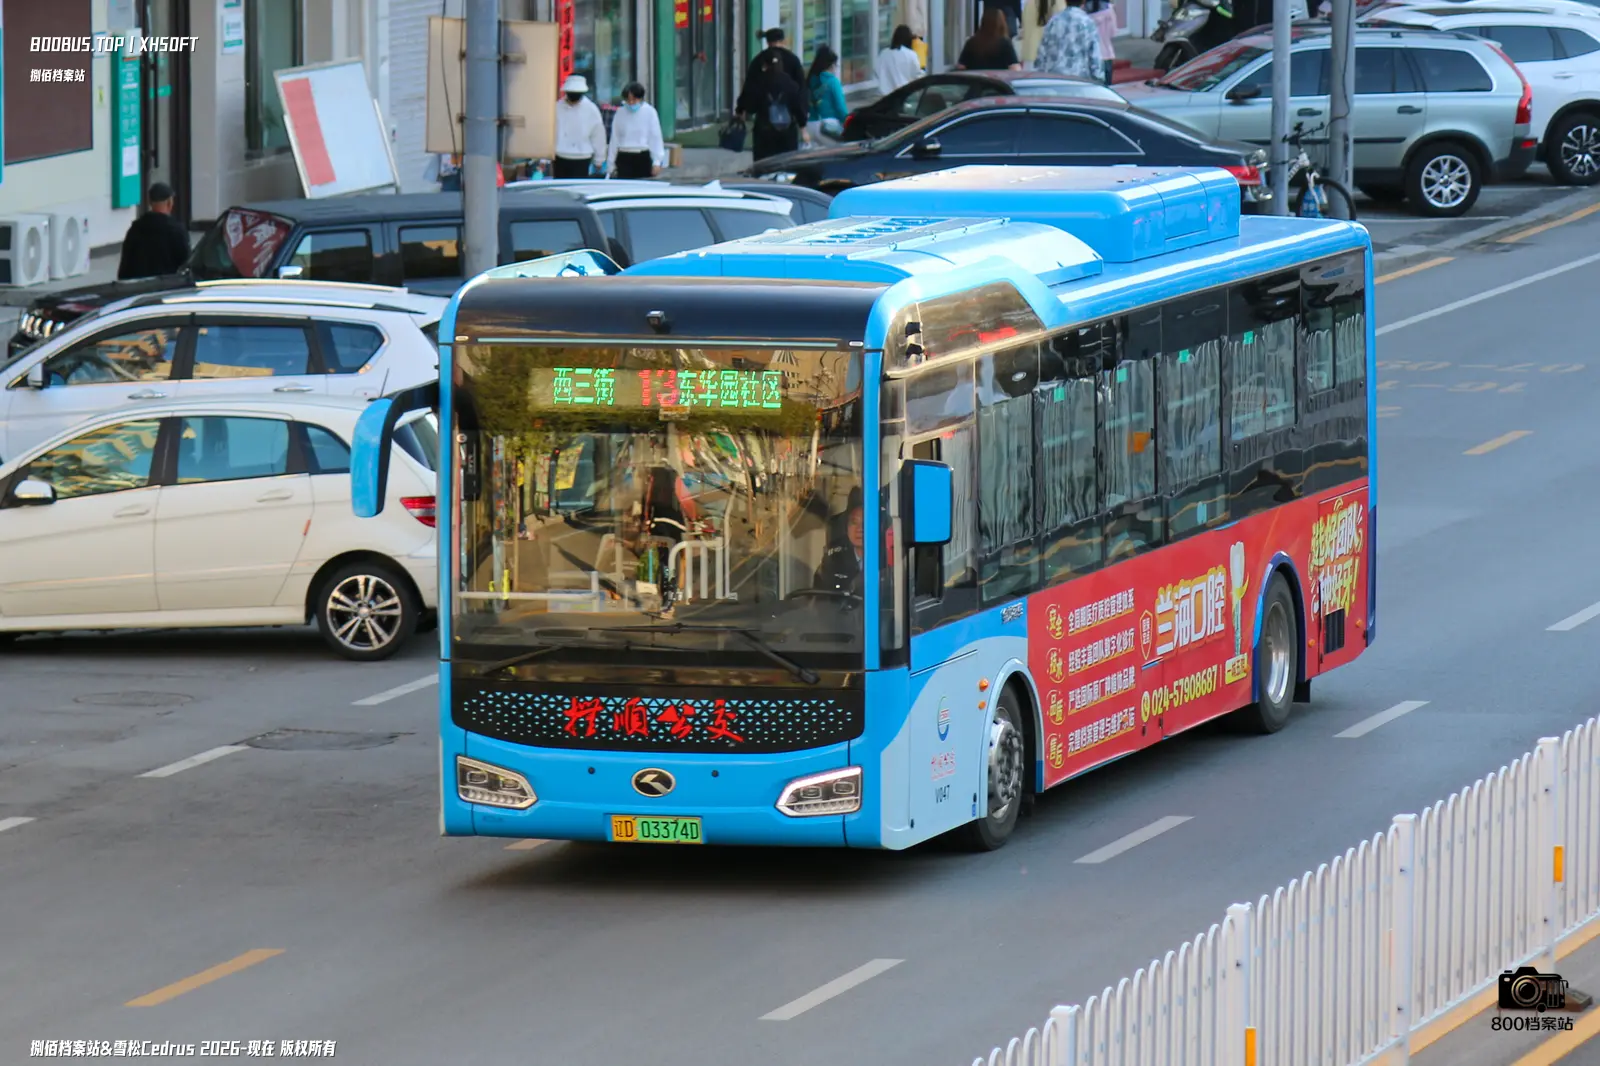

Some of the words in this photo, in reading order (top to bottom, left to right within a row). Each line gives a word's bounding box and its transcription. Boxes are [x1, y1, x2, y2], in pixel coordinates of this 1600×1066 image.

[553, 367, 615, 406] 西三街
[677, 370, 782, 409] 东华园社区
[1311, 501, 1360, 567] 选好团队
[1156, 570, 1225, 656] 兰海口腔
[1152, 664, 1218, 717] 024-57908687
